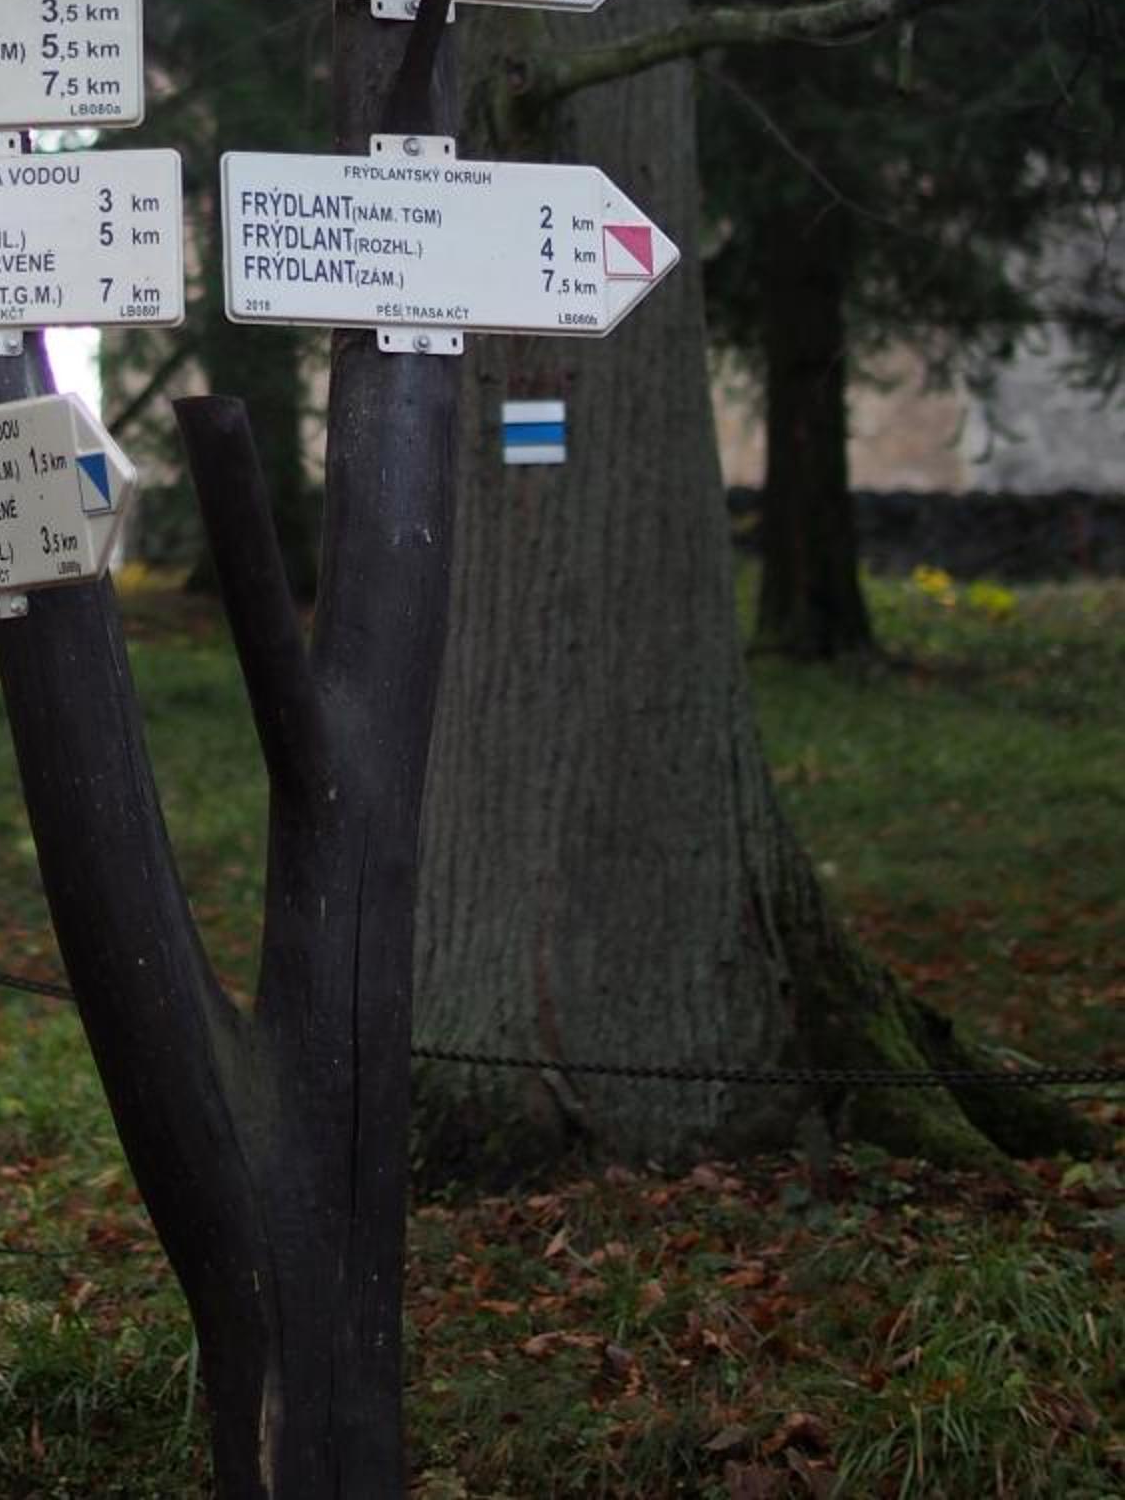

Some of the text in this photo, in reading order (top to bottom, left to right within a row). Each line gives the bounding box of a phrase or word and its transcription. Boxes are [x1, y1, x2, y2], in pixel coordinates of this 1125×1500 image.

[86, 2, 120, 22] km
[42, 33, 121, 61] 5,5 km
[42, 71, 121, 98] 7,5 km
[8, 166, 80, 185] VODOU
[344, 164, 492, 185] FRÝDLANTSKÝ OKRUH
[99, 188, 160, 213] 3 km
[403, 208, 442, 228] TGM)
[541, 206, 595, 232] 2 km
[100, 222, 160, 246] 5 km
[541, 238, 597, 264] 4 km
[101, 278, 160, 303] 7 km
[542, 271, 597, 295] 7,5 km
[0, 307, 24, 320] KČT
[377, 303, 469, 320] PĚŠÍ TRASA KČT
[50, 453, 67, 470] km
[40, 526, 78, 554] 3,5 km
